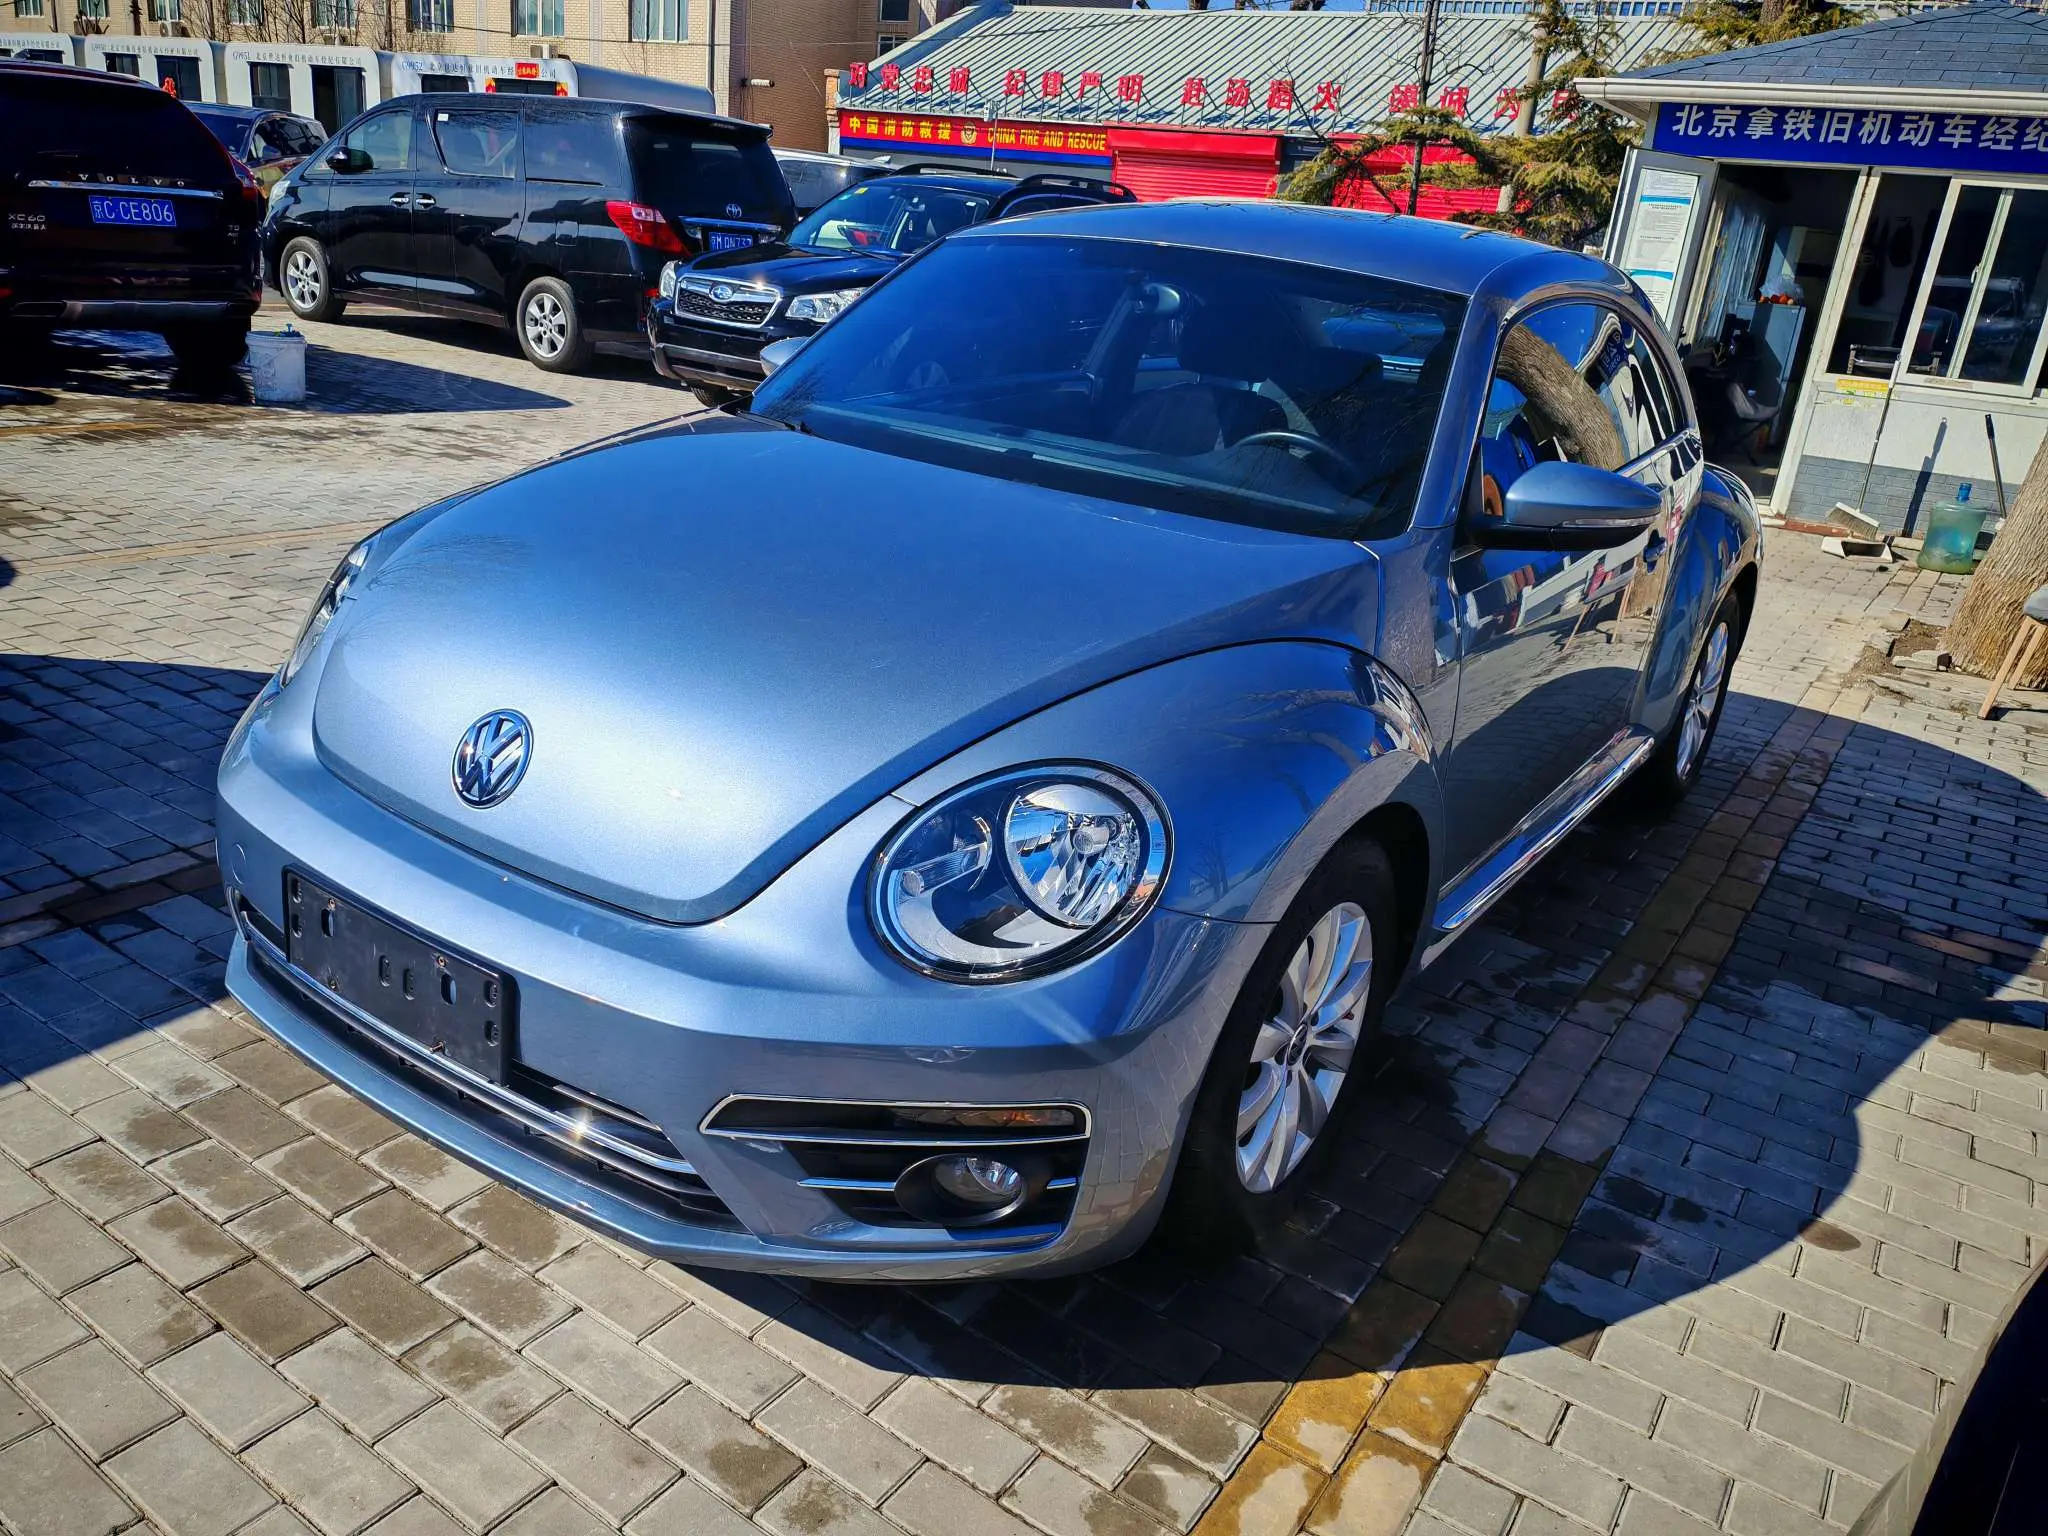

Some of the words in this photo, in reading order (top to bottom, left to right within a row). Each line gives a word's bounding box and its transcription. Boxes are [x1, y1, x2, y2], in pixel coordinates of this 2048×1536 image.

[849, 62, 971, 95] 对党忠诚
[1003, 69, 1144, 103] 纪律严明
[1181, 75, 1342, 112] 赴汤蹈火
[849, 116, 951, 140] 中国消防救援
[987, 127, 1016, 145] CHINA
[1019, 129, 1040, 146] FIRE
[1043, 131, 1064, 147] AND
[1067, 132, 1107, 150] RESCUE
[1671, 104, 2048, 152] 北京拿铁旧机动车经纪
[78, 173, 185, 187] VOLVO
